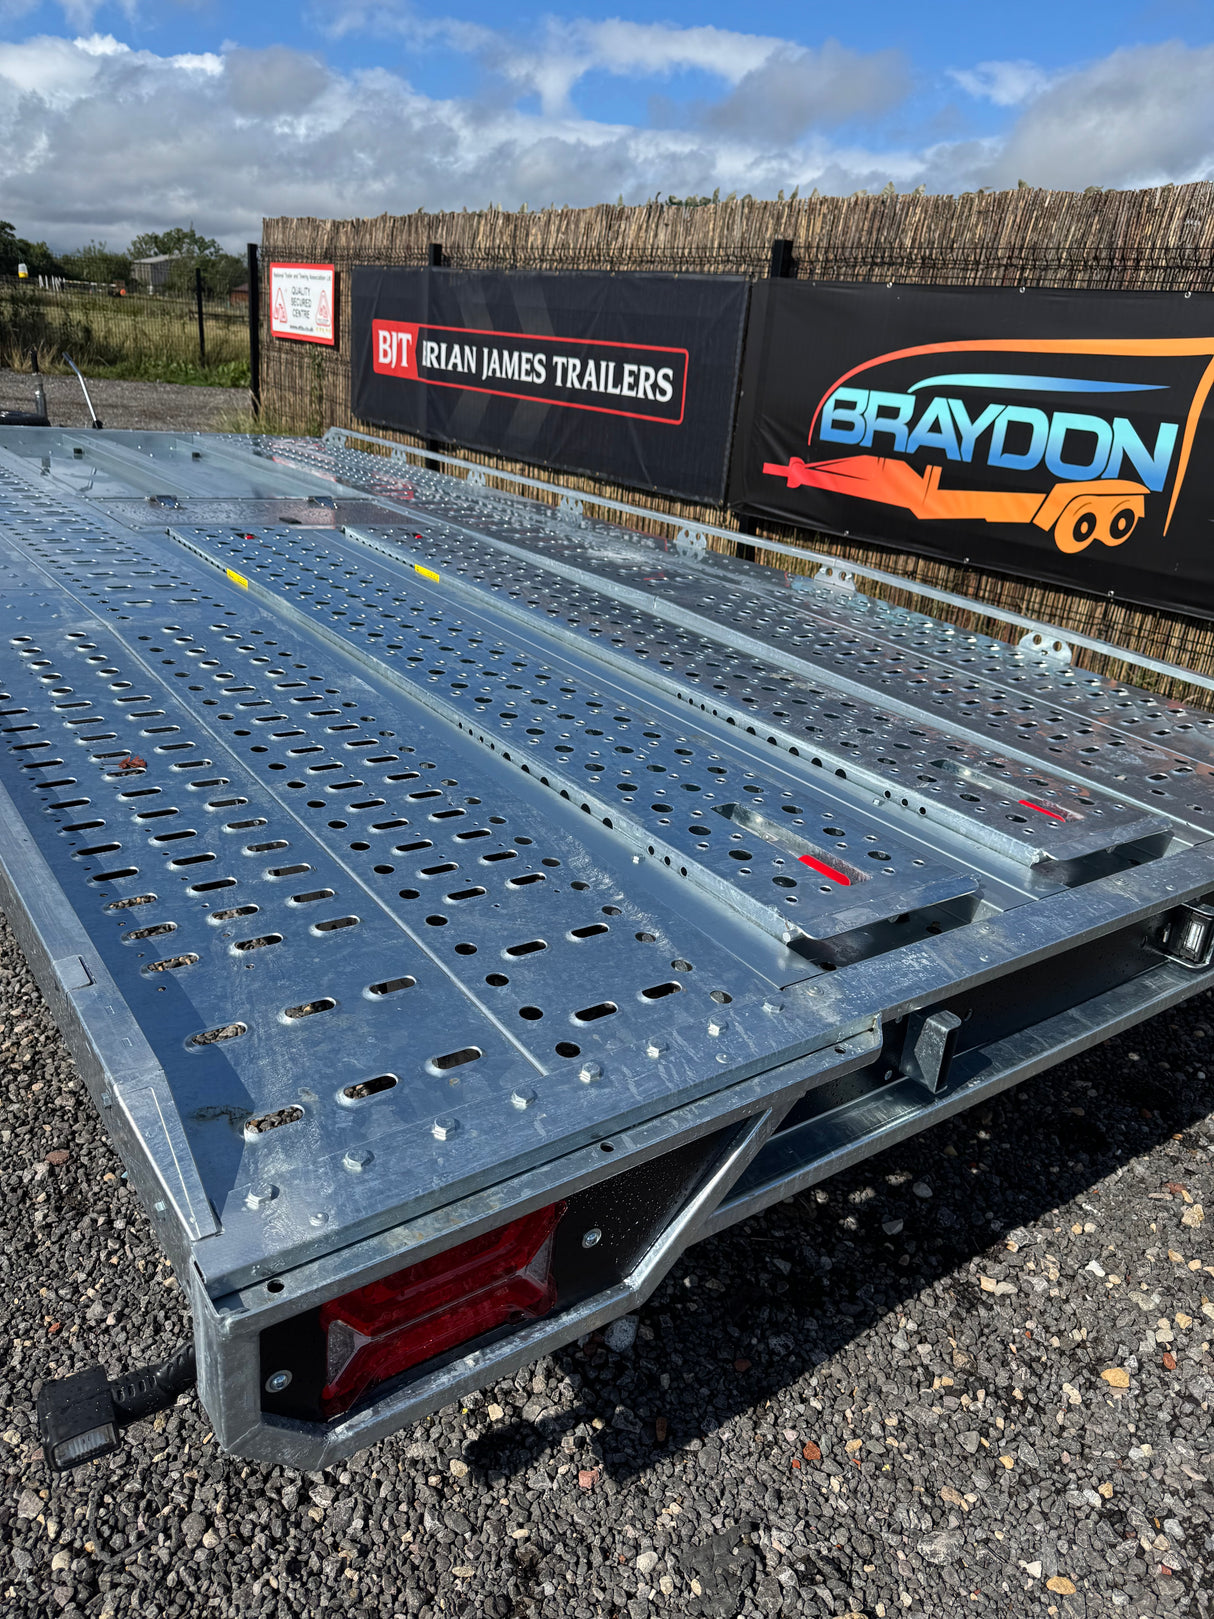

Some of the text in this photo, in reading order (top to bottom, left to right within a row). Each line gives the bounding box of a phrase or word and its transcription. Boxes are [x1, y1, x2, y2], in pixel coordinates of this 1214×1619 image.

[291, 286, 311, 296] QUALITY
[291, 297, 312, 308] SECURED
[292, 308, 310, 319] CENTRE
[378, 329, 412, 369] BJT
[482, 347, 547, 385] JAMES
[552, 355, 674, 403] TRAILERS
[819, 386, 1180, 493] BRAYDON
